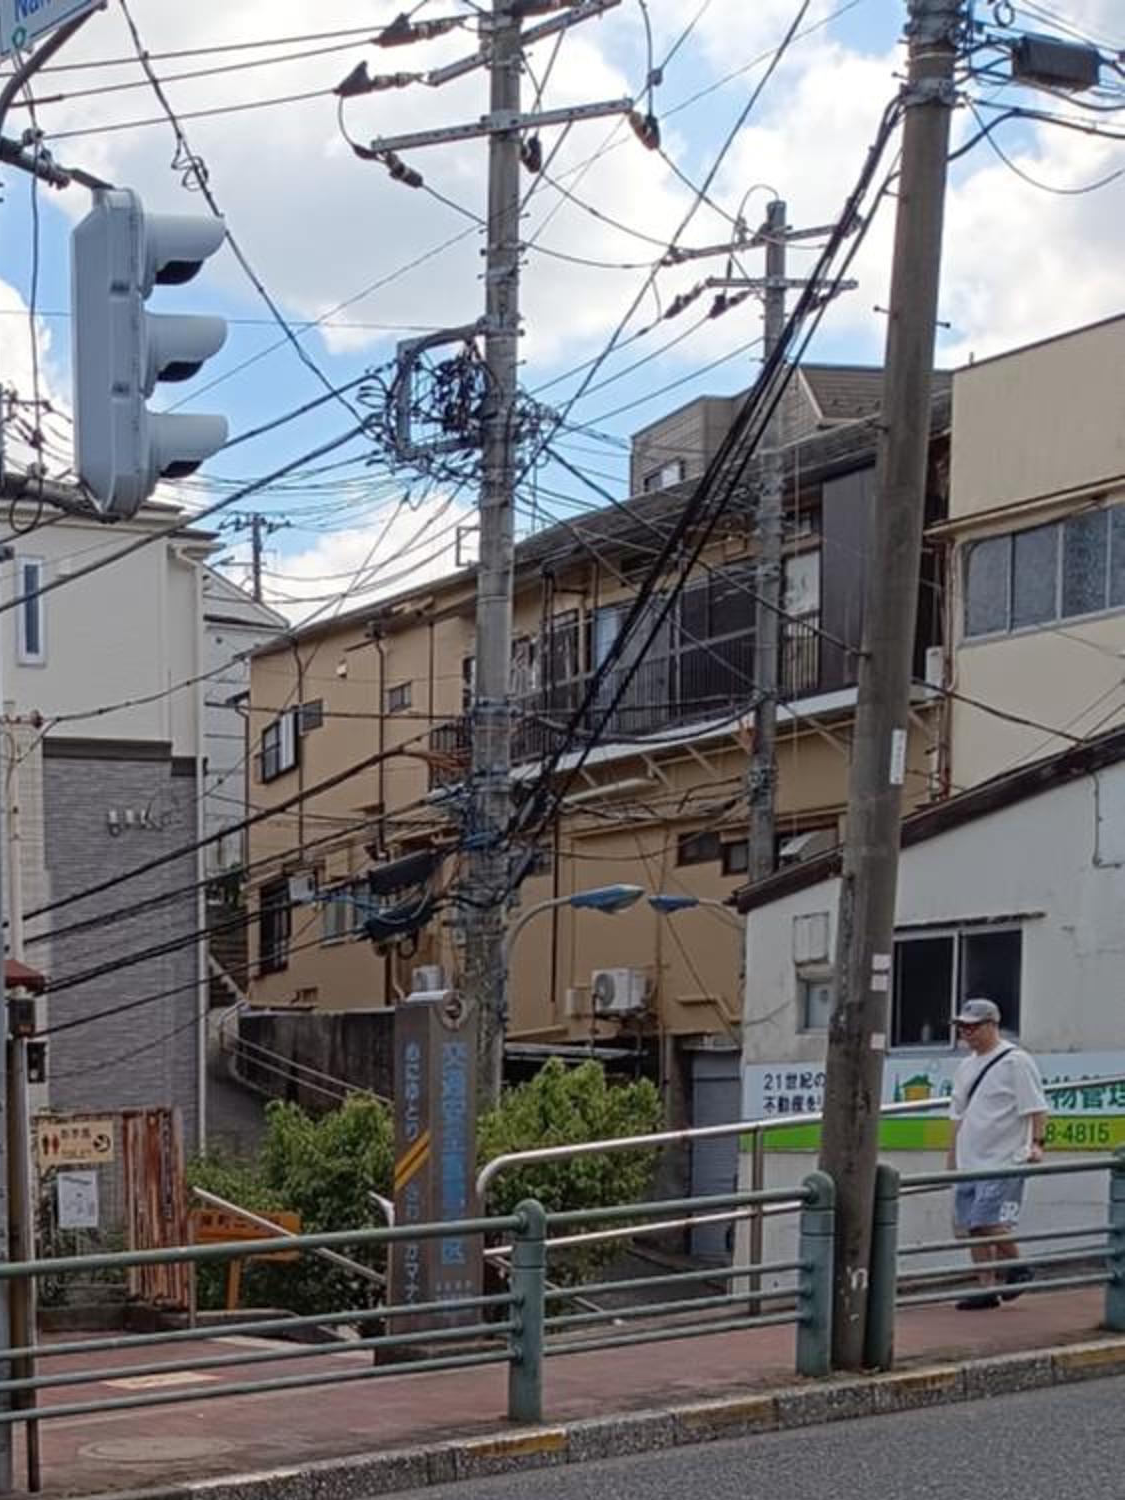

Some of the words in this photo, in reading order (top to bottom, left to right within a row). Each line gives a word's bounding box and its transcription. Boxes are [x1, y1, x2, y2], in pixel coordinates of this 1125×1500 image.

[763, 1072, 827, 1091] 21世紀の
[1043, 1075, 1125, 1110] 物管理
